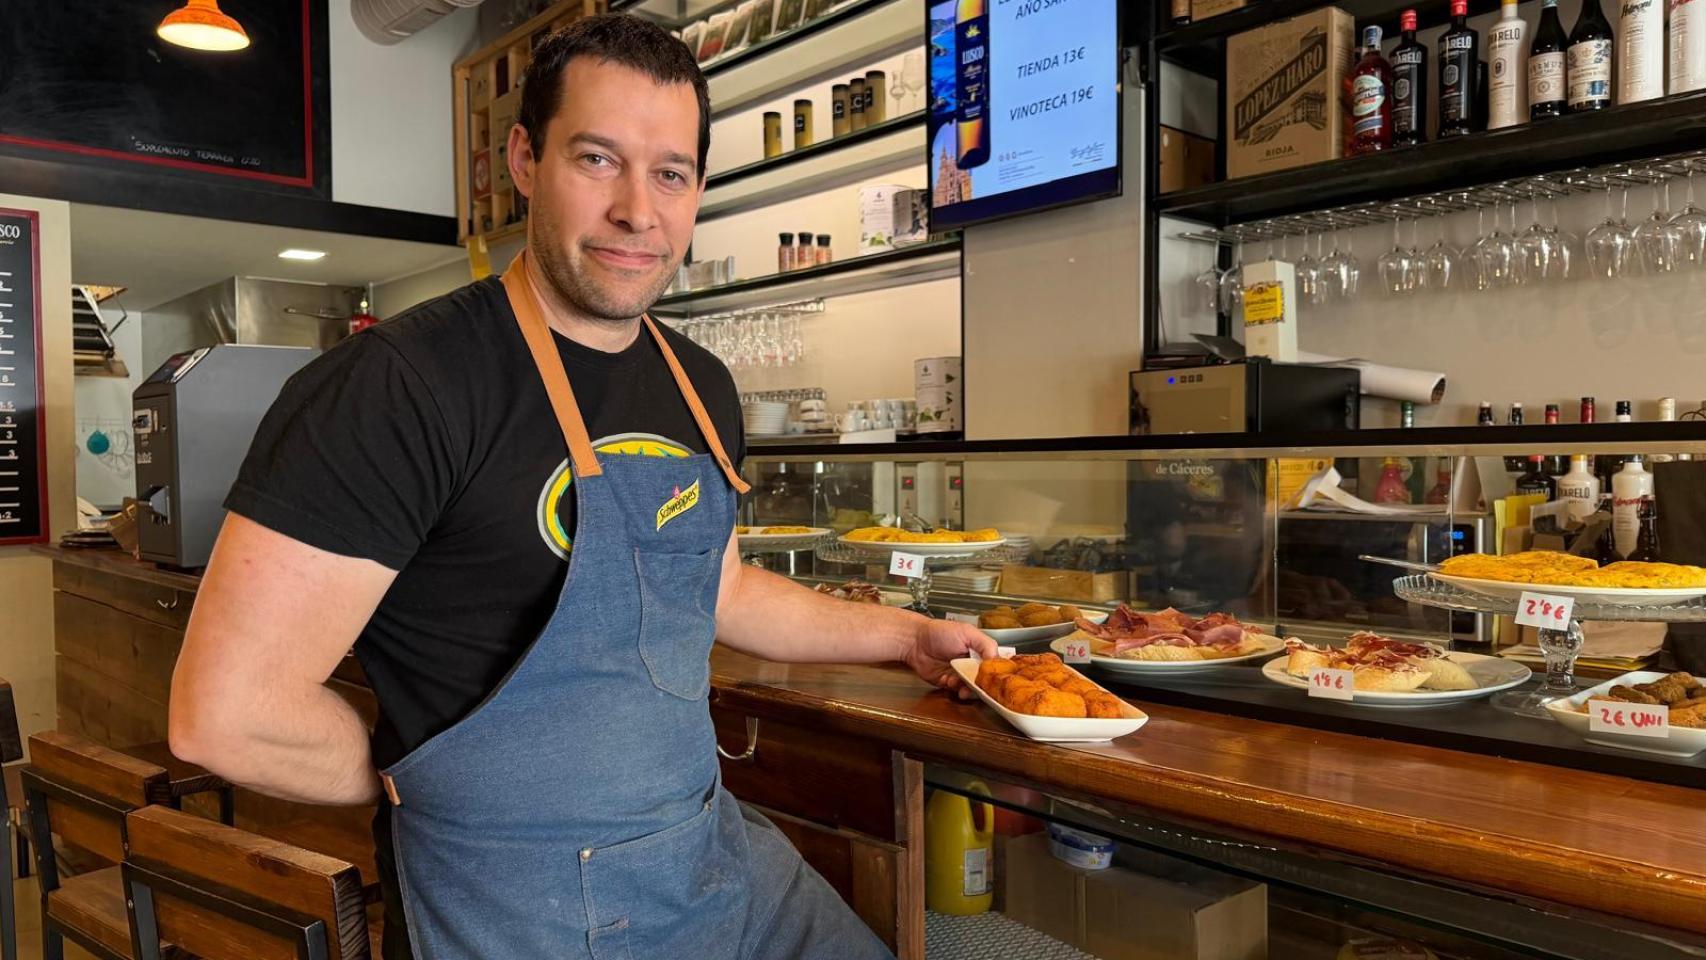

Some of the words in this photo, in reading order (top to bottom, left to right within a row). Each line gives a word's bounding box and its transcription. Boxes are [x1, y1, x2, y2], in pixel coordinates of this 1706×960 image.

[1017, 54, 1059, 79] TIENDA
[1063, 46, 1085, 64] 13€
[1009, 93, 1067, 121] VINOTECA
[1071, 85, 1094, 104] 19€
[1265, 145, 1294, 157] RIOJA
[1155, 462, 1168, 474] de
[1169, 460, 1214, 476] Cáceres
[660, 488, 696, 523] Schweppes
[1631, 711, 1662, 728] UNI
